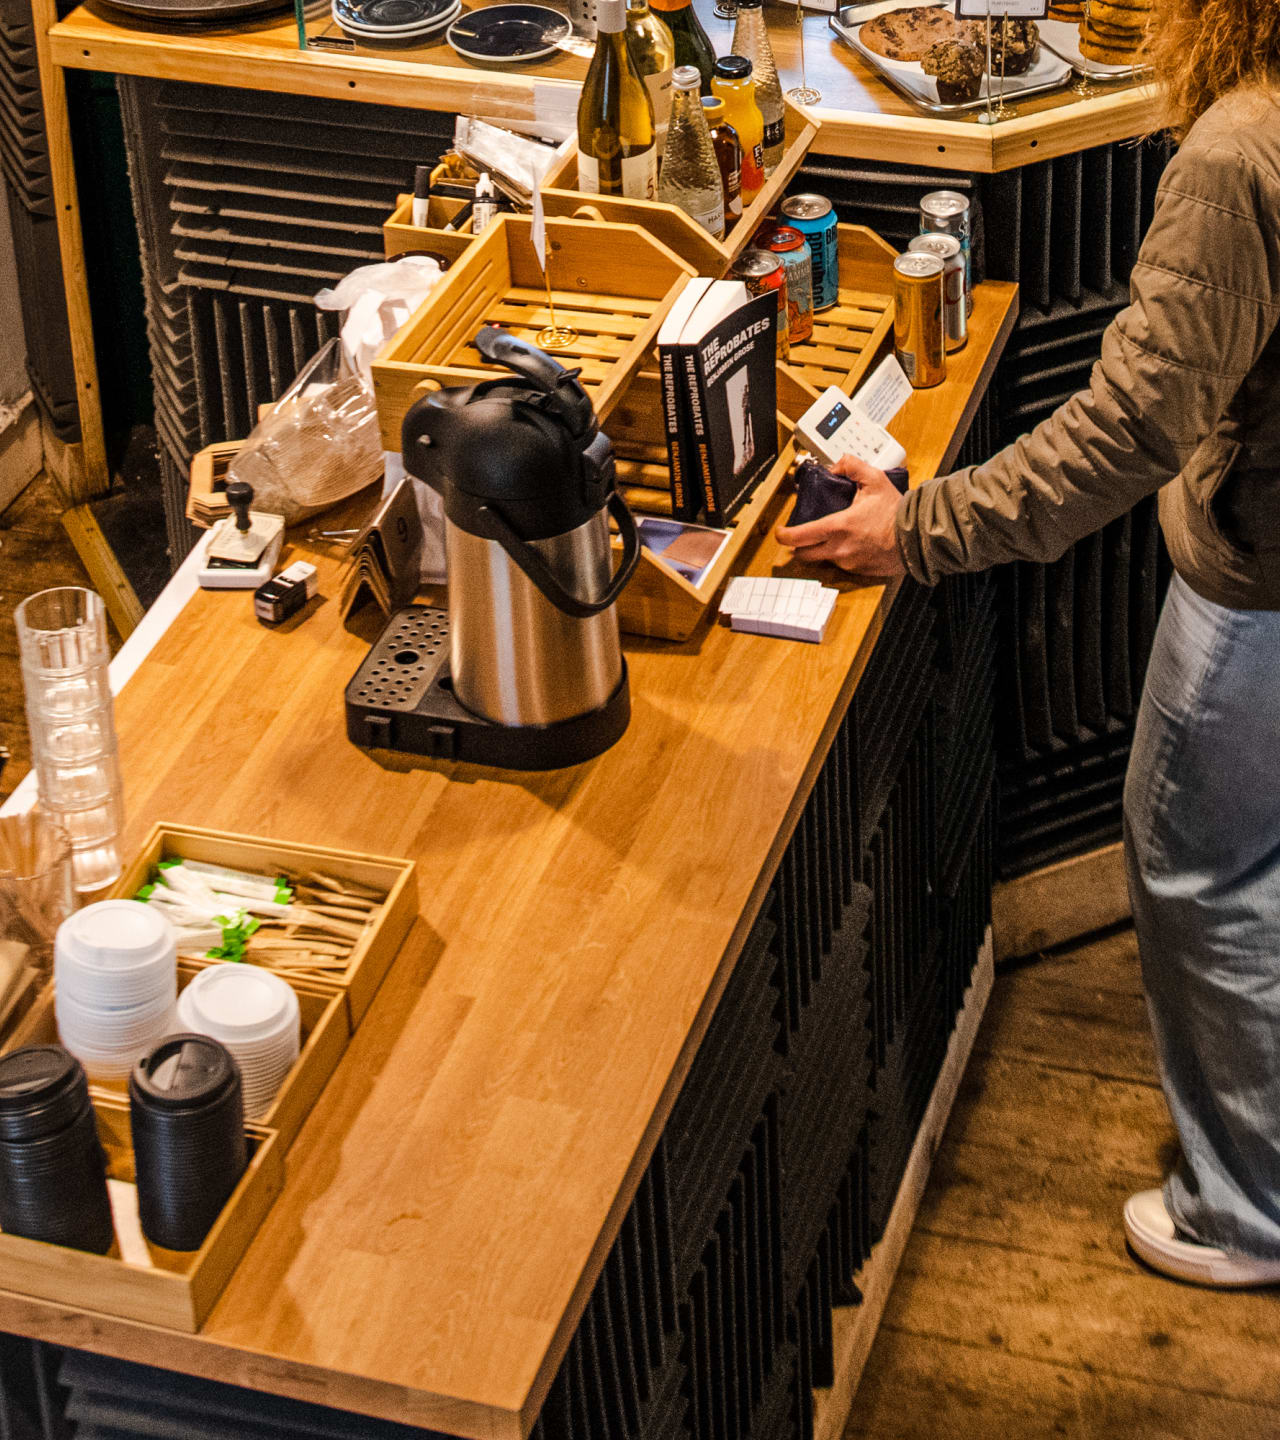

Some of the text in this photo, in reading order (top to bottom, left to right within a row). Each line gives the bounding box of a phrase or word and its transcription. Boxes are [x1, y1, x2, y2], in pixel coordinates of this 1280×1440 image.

[701, 336, 720, 361] THE
[704, 317, 771, 375] REPROBATES
[706, 340, 756, 388] BENJAMIN GROSE
[662, 354, 683, 508] THE REPROBATES BENJAMIN GROSE
[684, 355, 716, 512] THE REPROBATES BENJAMIN GROSE
